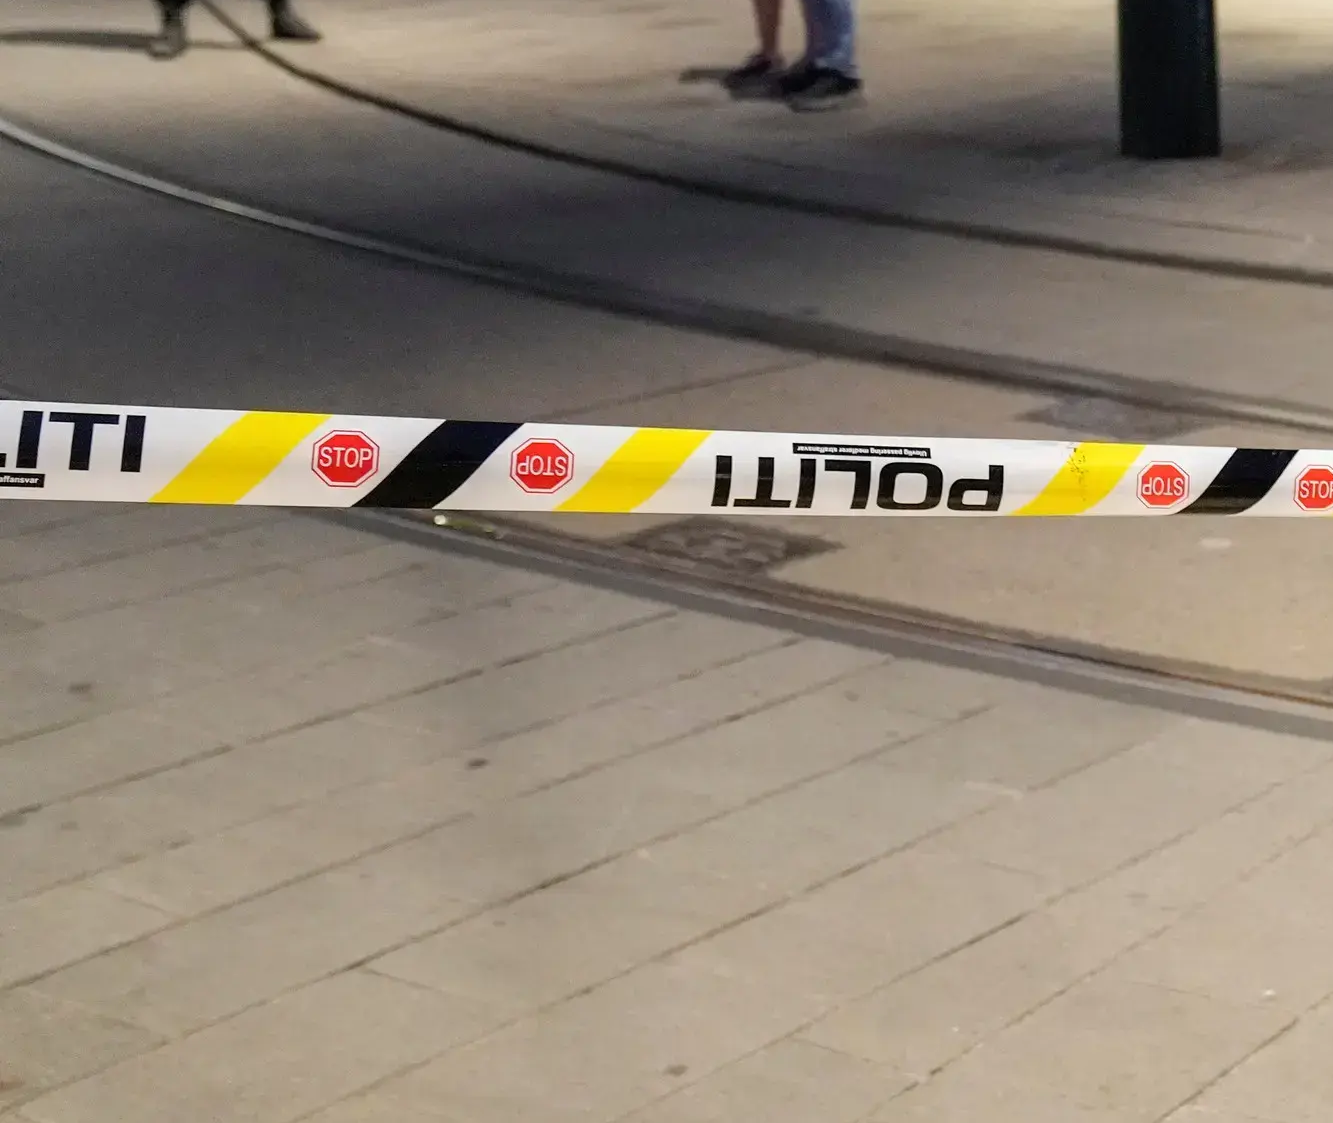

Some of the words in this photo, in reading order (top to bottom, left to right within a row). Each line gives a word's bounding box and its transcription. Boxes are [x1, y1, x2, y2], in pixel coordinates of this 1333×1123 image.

[320, 444, 373, 469] STOP
[516, 456, 568, 478] STOP
[710, 455, 1004, 512] POLITI
[1142, 475, 1183, 499] STOP
